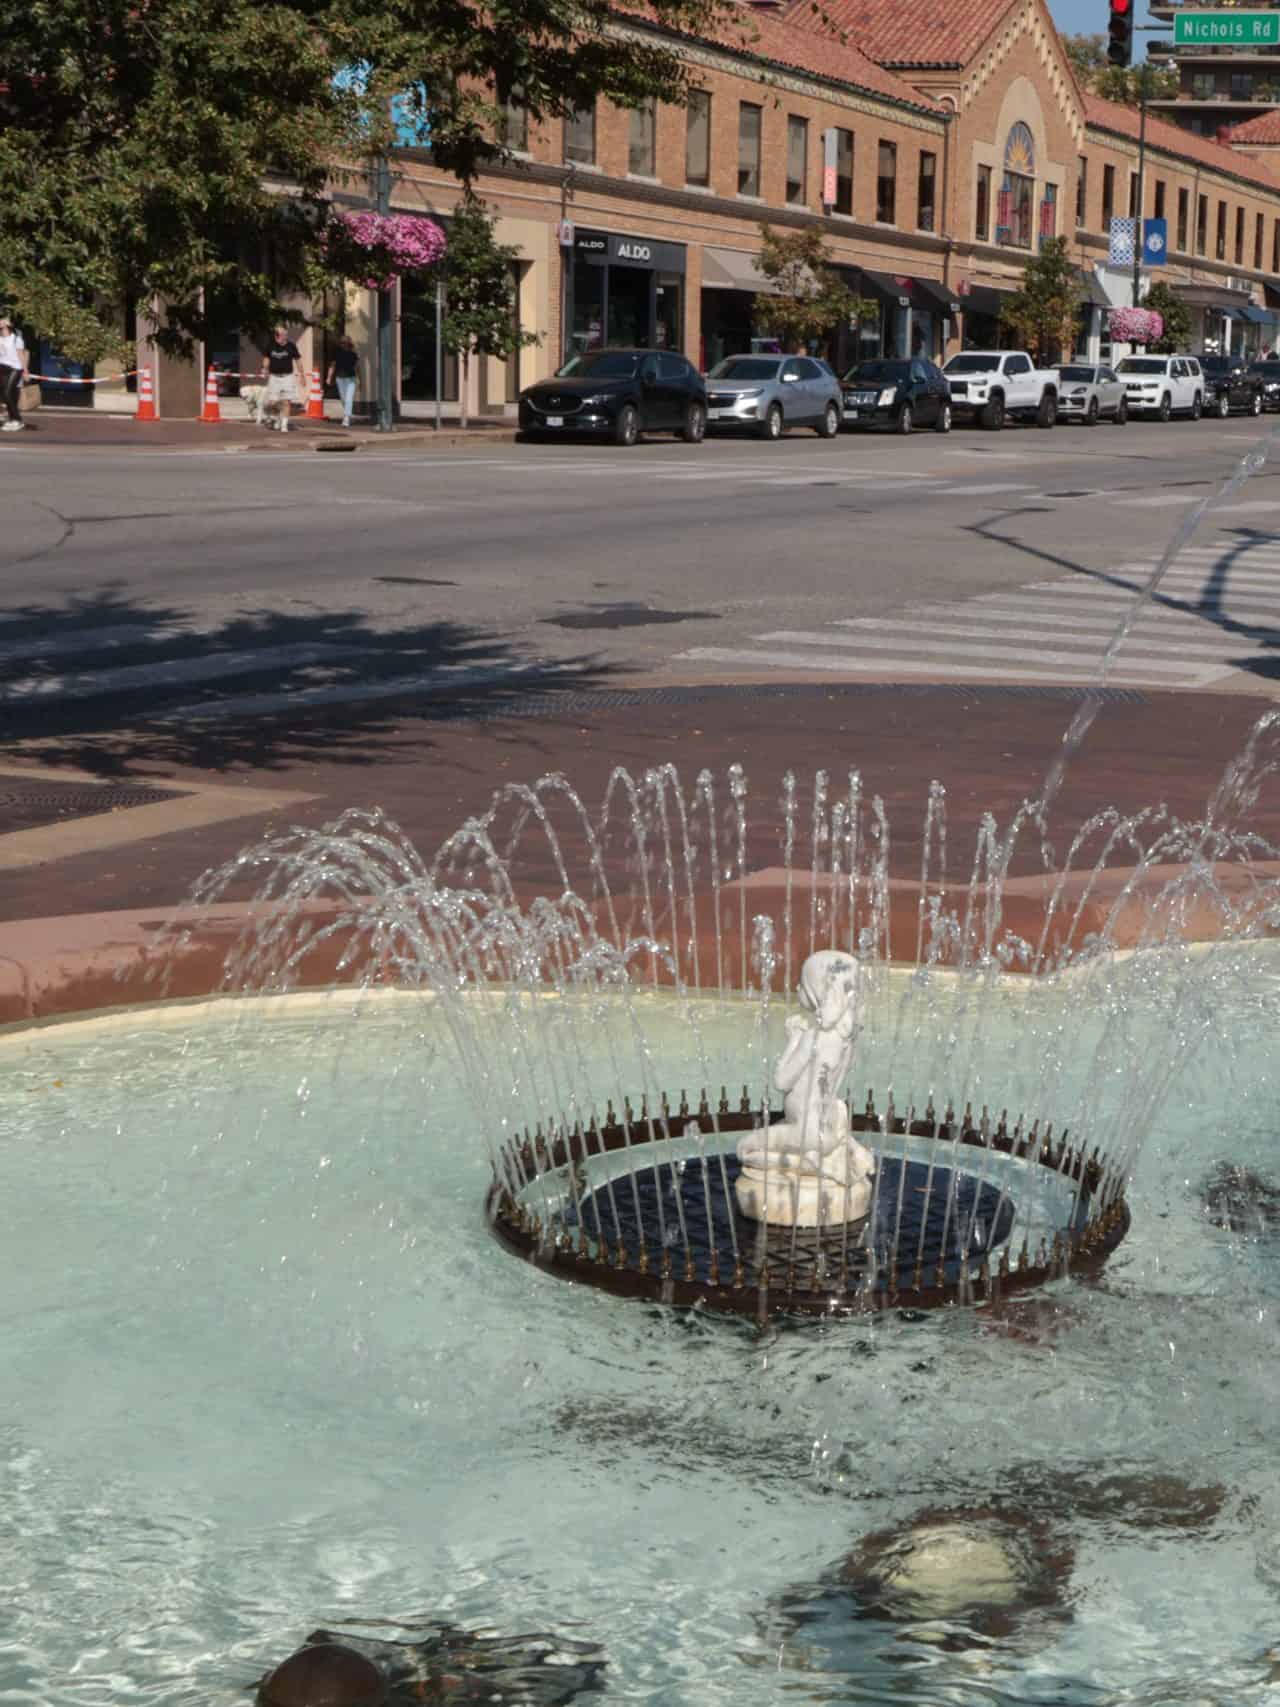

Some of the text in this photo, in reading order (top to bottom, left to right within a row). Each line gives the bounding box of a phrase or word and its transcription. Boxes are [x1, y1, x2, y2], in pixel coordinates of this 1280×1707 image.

[1184, 21, 1271, 37] Nichols Rd
[578, 240, 605, 249] ALDO
[618, 243, 651, 260] ALDO
